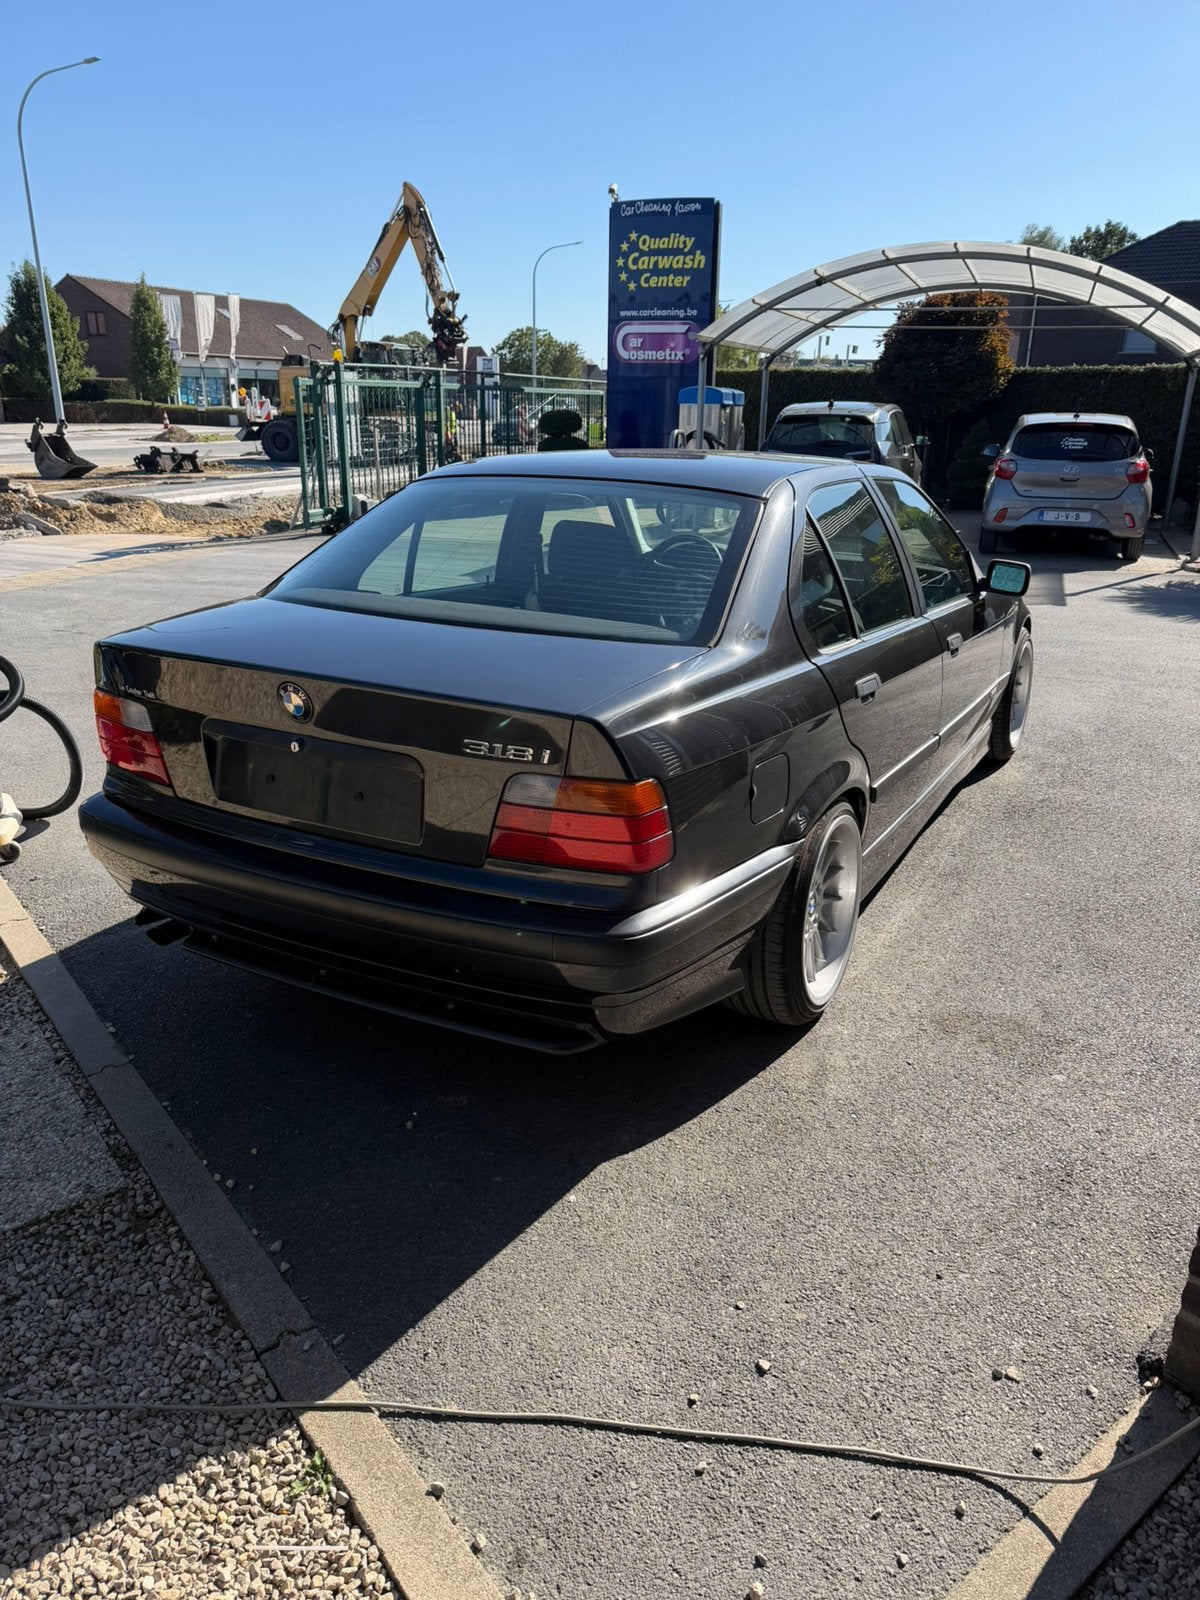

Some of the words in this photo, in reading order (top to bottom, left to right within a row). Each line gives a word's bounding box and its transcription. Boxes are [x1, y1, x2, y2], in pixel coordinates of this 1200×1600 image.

[620, 204, 634, 216] Car
[635, 201, 672, 216] Cleaning
[674, 200, 702, 216] Jason
[638, 233, 695, 252] Quality
[627, 250, 706, 270] Carwash
[640, 273, 691, 288] Center
[620, 307, 698, 318] www.carcleaning.be
